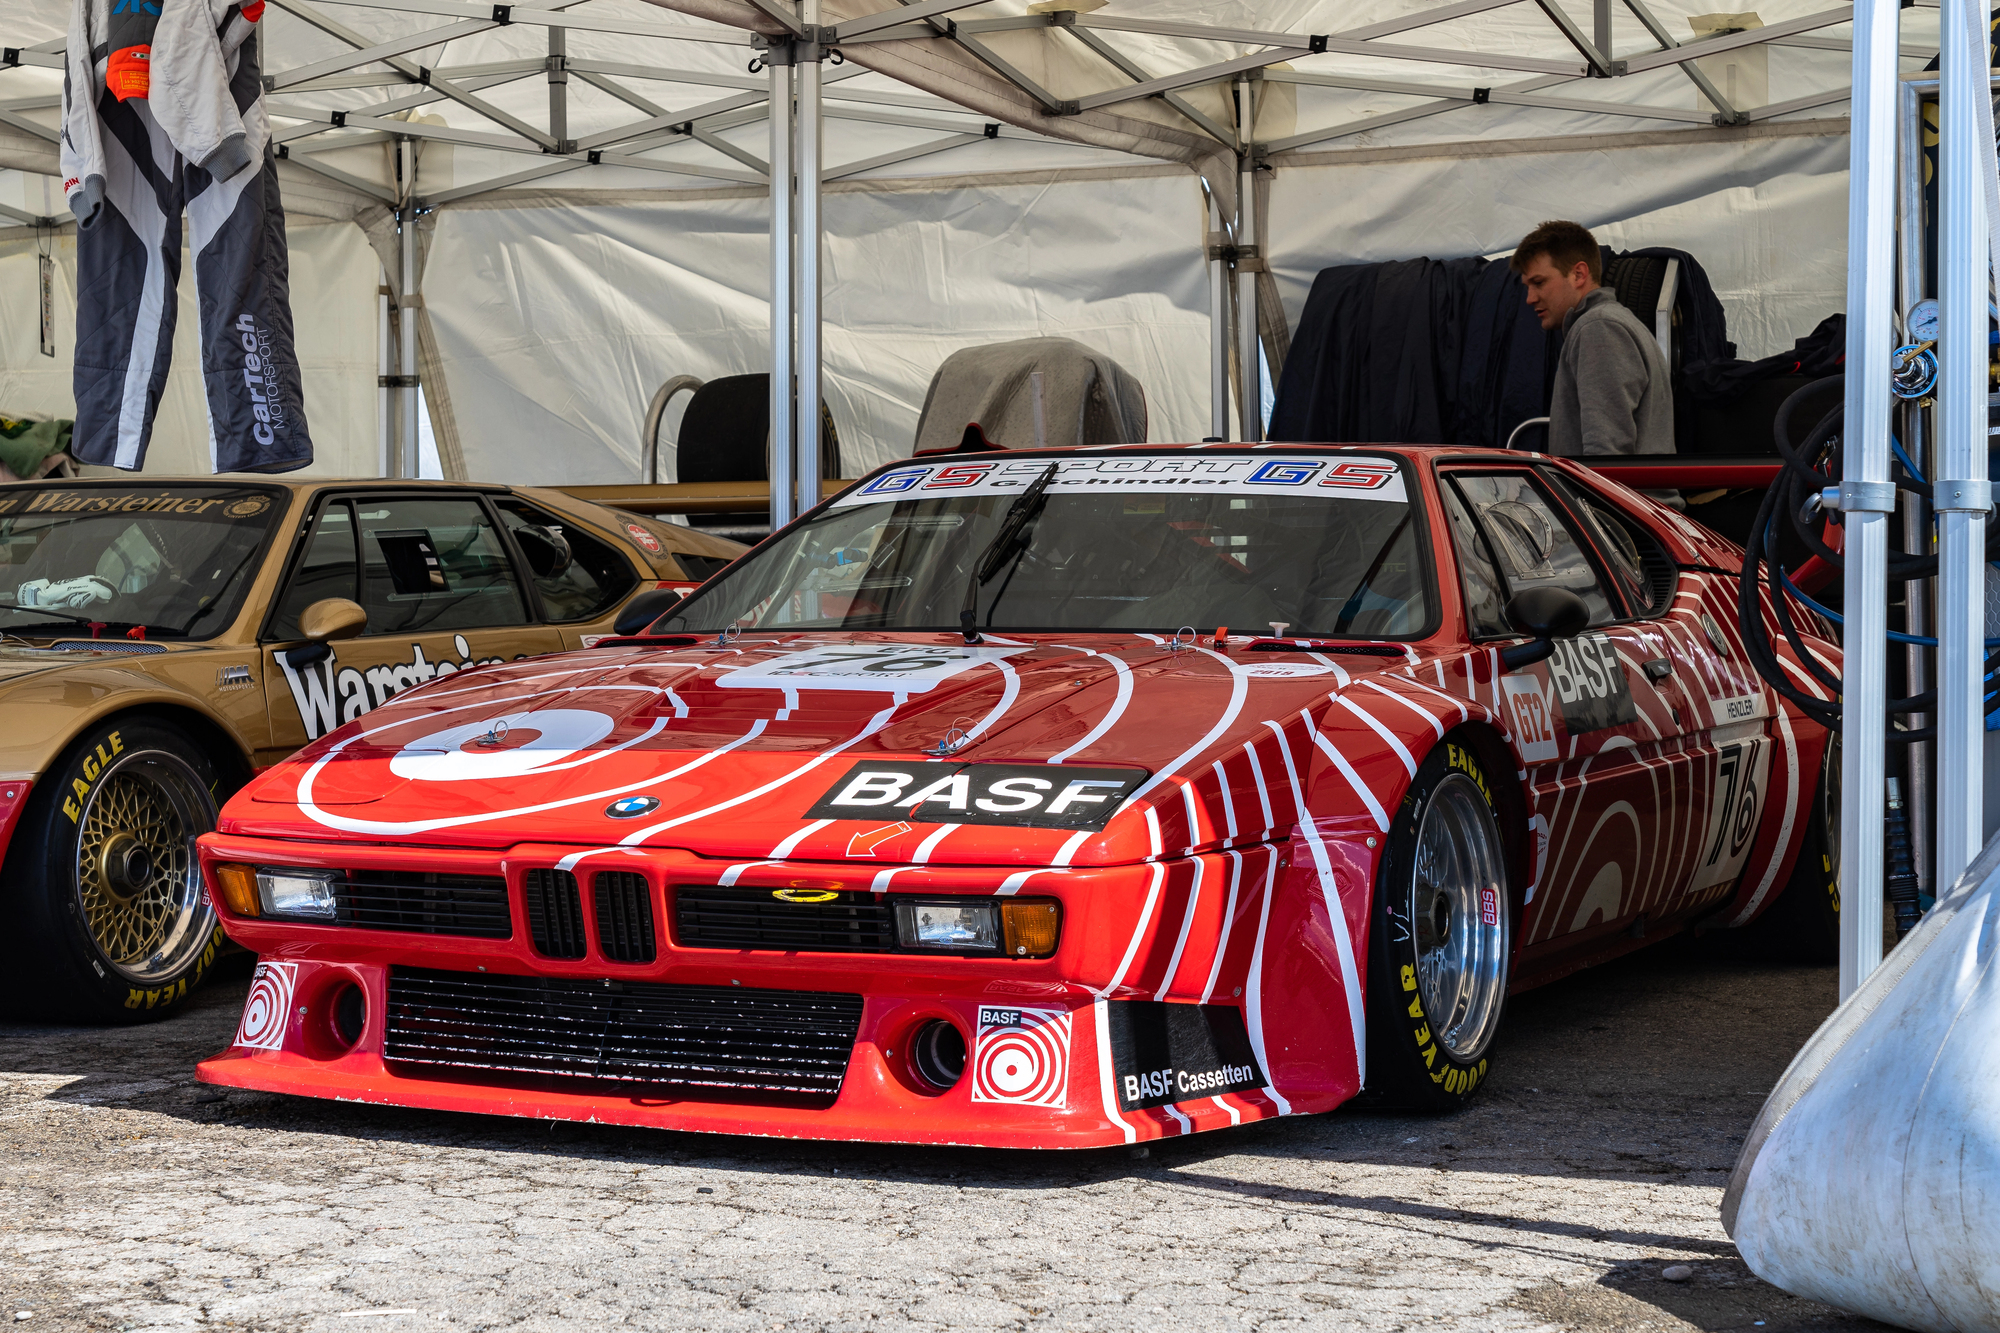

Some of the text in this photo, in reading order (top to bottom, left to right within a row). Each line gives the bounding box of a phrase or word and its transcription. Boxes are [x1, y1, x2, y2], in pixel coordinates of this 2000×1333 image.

[236, 313, 275, 446] CarTech
[256, 326, 285, 430] MOTORSPORT
[999, 458, 1253, 476] SPORT
[24, 492, 225, 515] Warsteiner
[779, 652, 971, 673] 76
[1548, 633, 1617, 704] BASF
[218, 683, 255, 692] MOTORSPORTS
[1513, 692, 1552, 744] GT2
[1726, 699, 1755, 719] HENZLER
[62, 730, 124, 825] EAGLE
[829, 771, 1126, 815] BASF
[1447, 743, 1493, 807] EAGLE
[1706, 738, 1759, 868] 76
[1483, 889, 1496, 925] BBS
[981, 1010, 1020, 1025] BASF
[1124, 1063, 1254, 1102] BASF Cassetten
